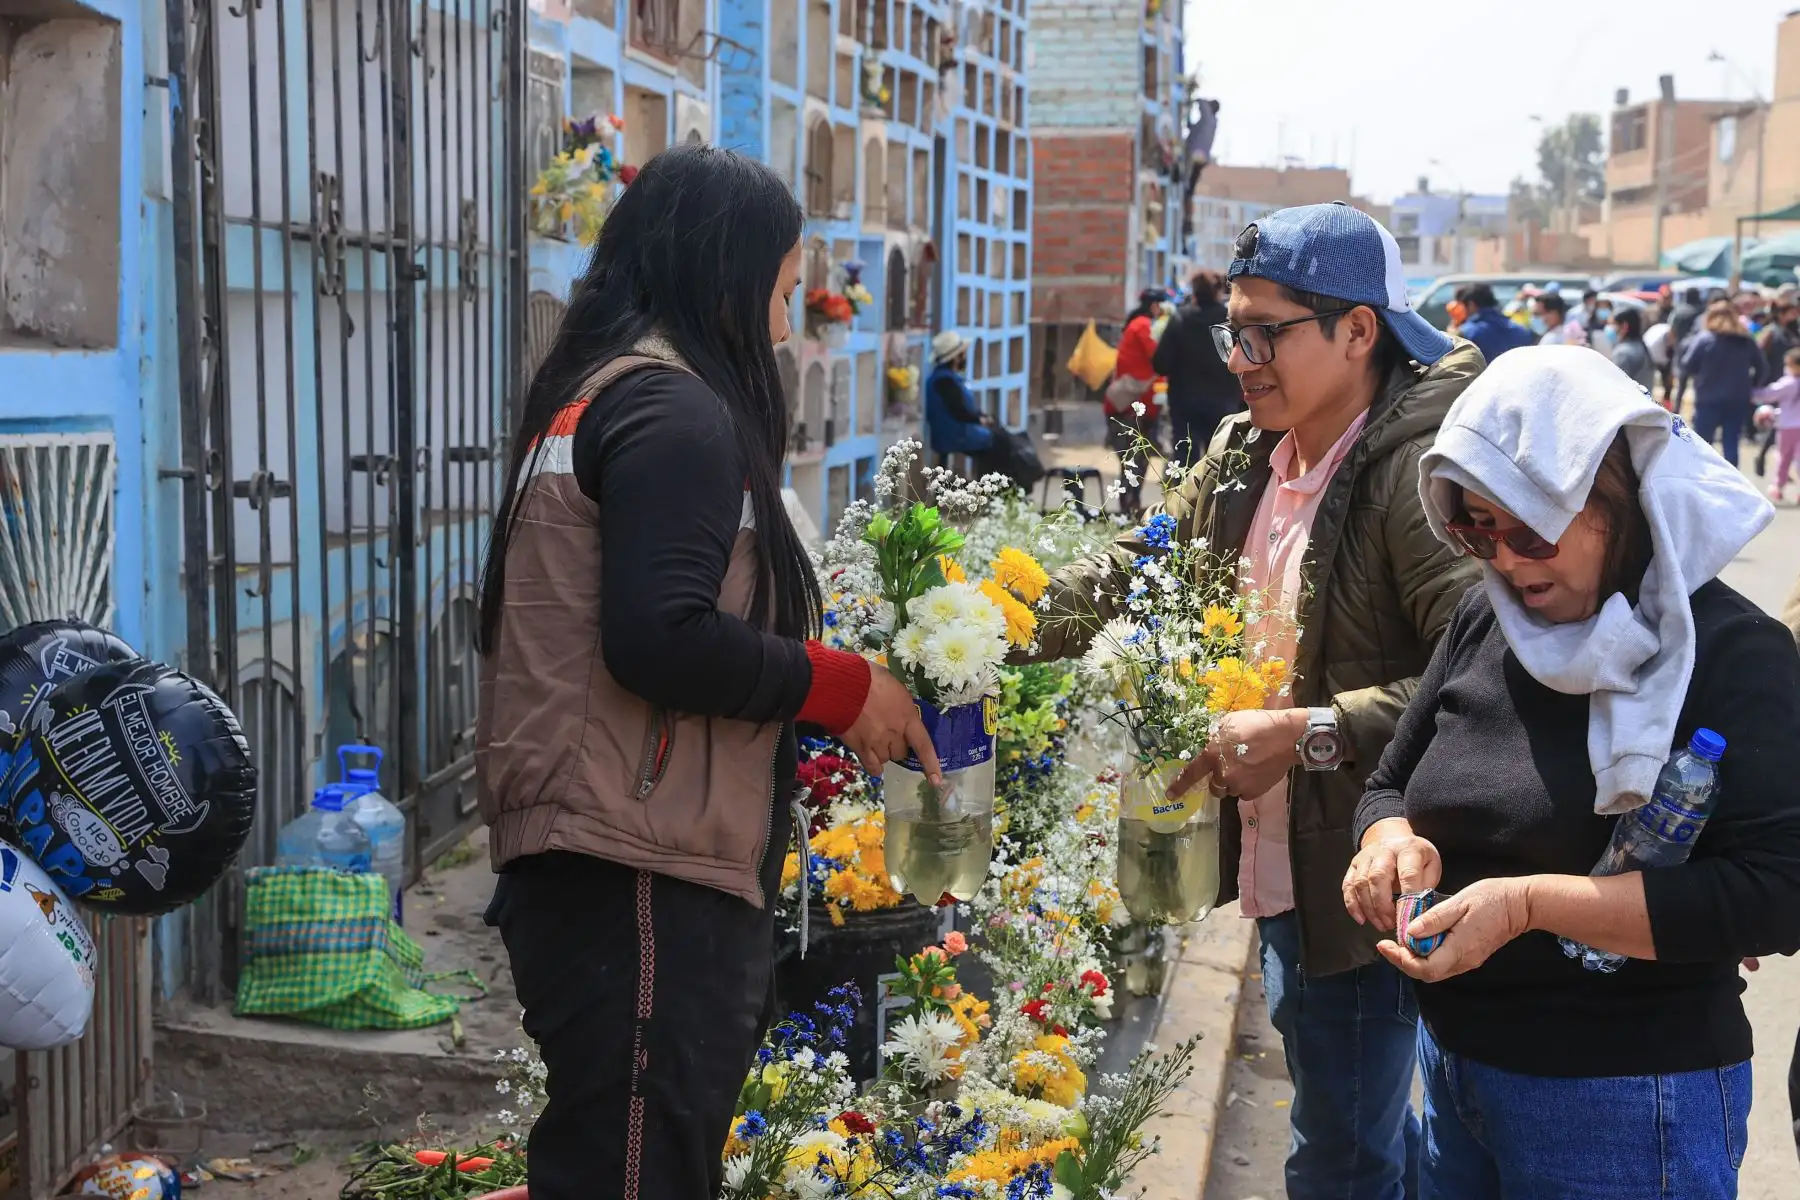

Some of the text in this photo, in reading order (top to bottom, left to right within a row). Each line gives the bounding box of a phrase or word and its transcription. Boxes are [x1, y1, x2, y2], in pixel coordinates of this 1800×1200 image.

[53, 650, 70, 670] EL
[47, 708, 155, 846] QUE EN MI VIDA
[119, 692, 193, 823] EL MEJOR HOMBRE
[56, 930, 82, 961] ser
